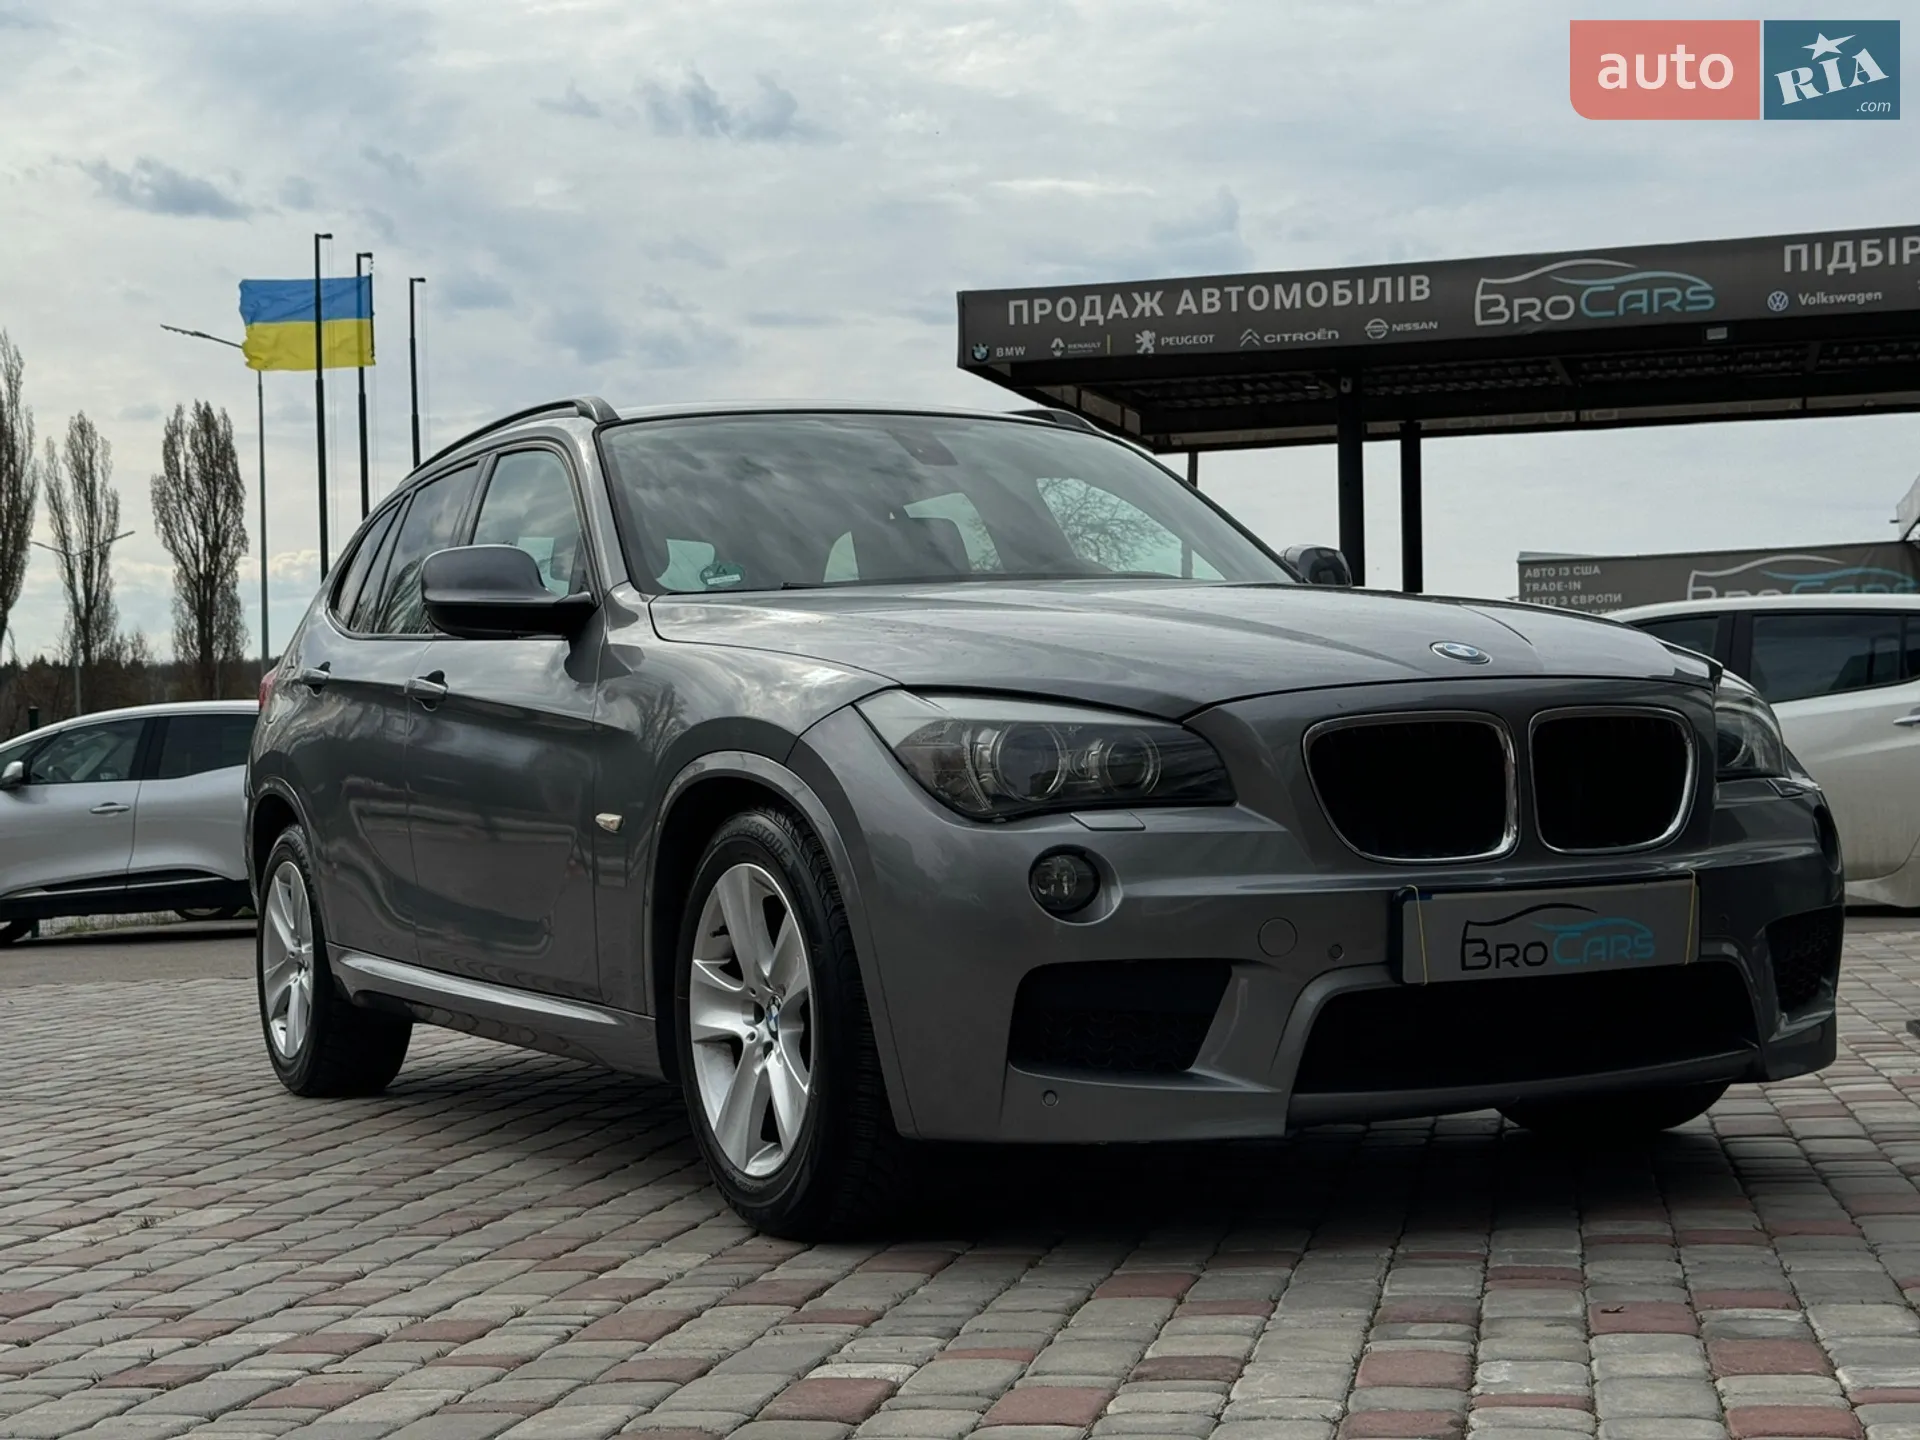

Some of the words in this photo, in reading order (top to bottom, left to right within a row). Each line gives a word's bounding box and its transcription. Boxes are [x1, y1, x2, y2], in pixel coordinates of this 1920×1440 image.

[1783, 236, 1920, 276] ПІДБІР
[1007, 290, 1165, 326] ПРОДАЖ
[1175, 274, 1432, 317] АВТОМОБІЛІВ
[1797, 291, 1883, 306] Volkswagen
[1391, 321, 1439, 332] NISSAN
[1160, 333, 1216, 346] PEUGEOT
[995, 346, 1027, 358] BMW
[1524, 567, 1556, 578] АВТО
[1573, 565, 1602, 576] США
[1525, 581, 1582, 592] TRADE-IN
[1570, 593, 1623, 605] ЄВРОПИ
